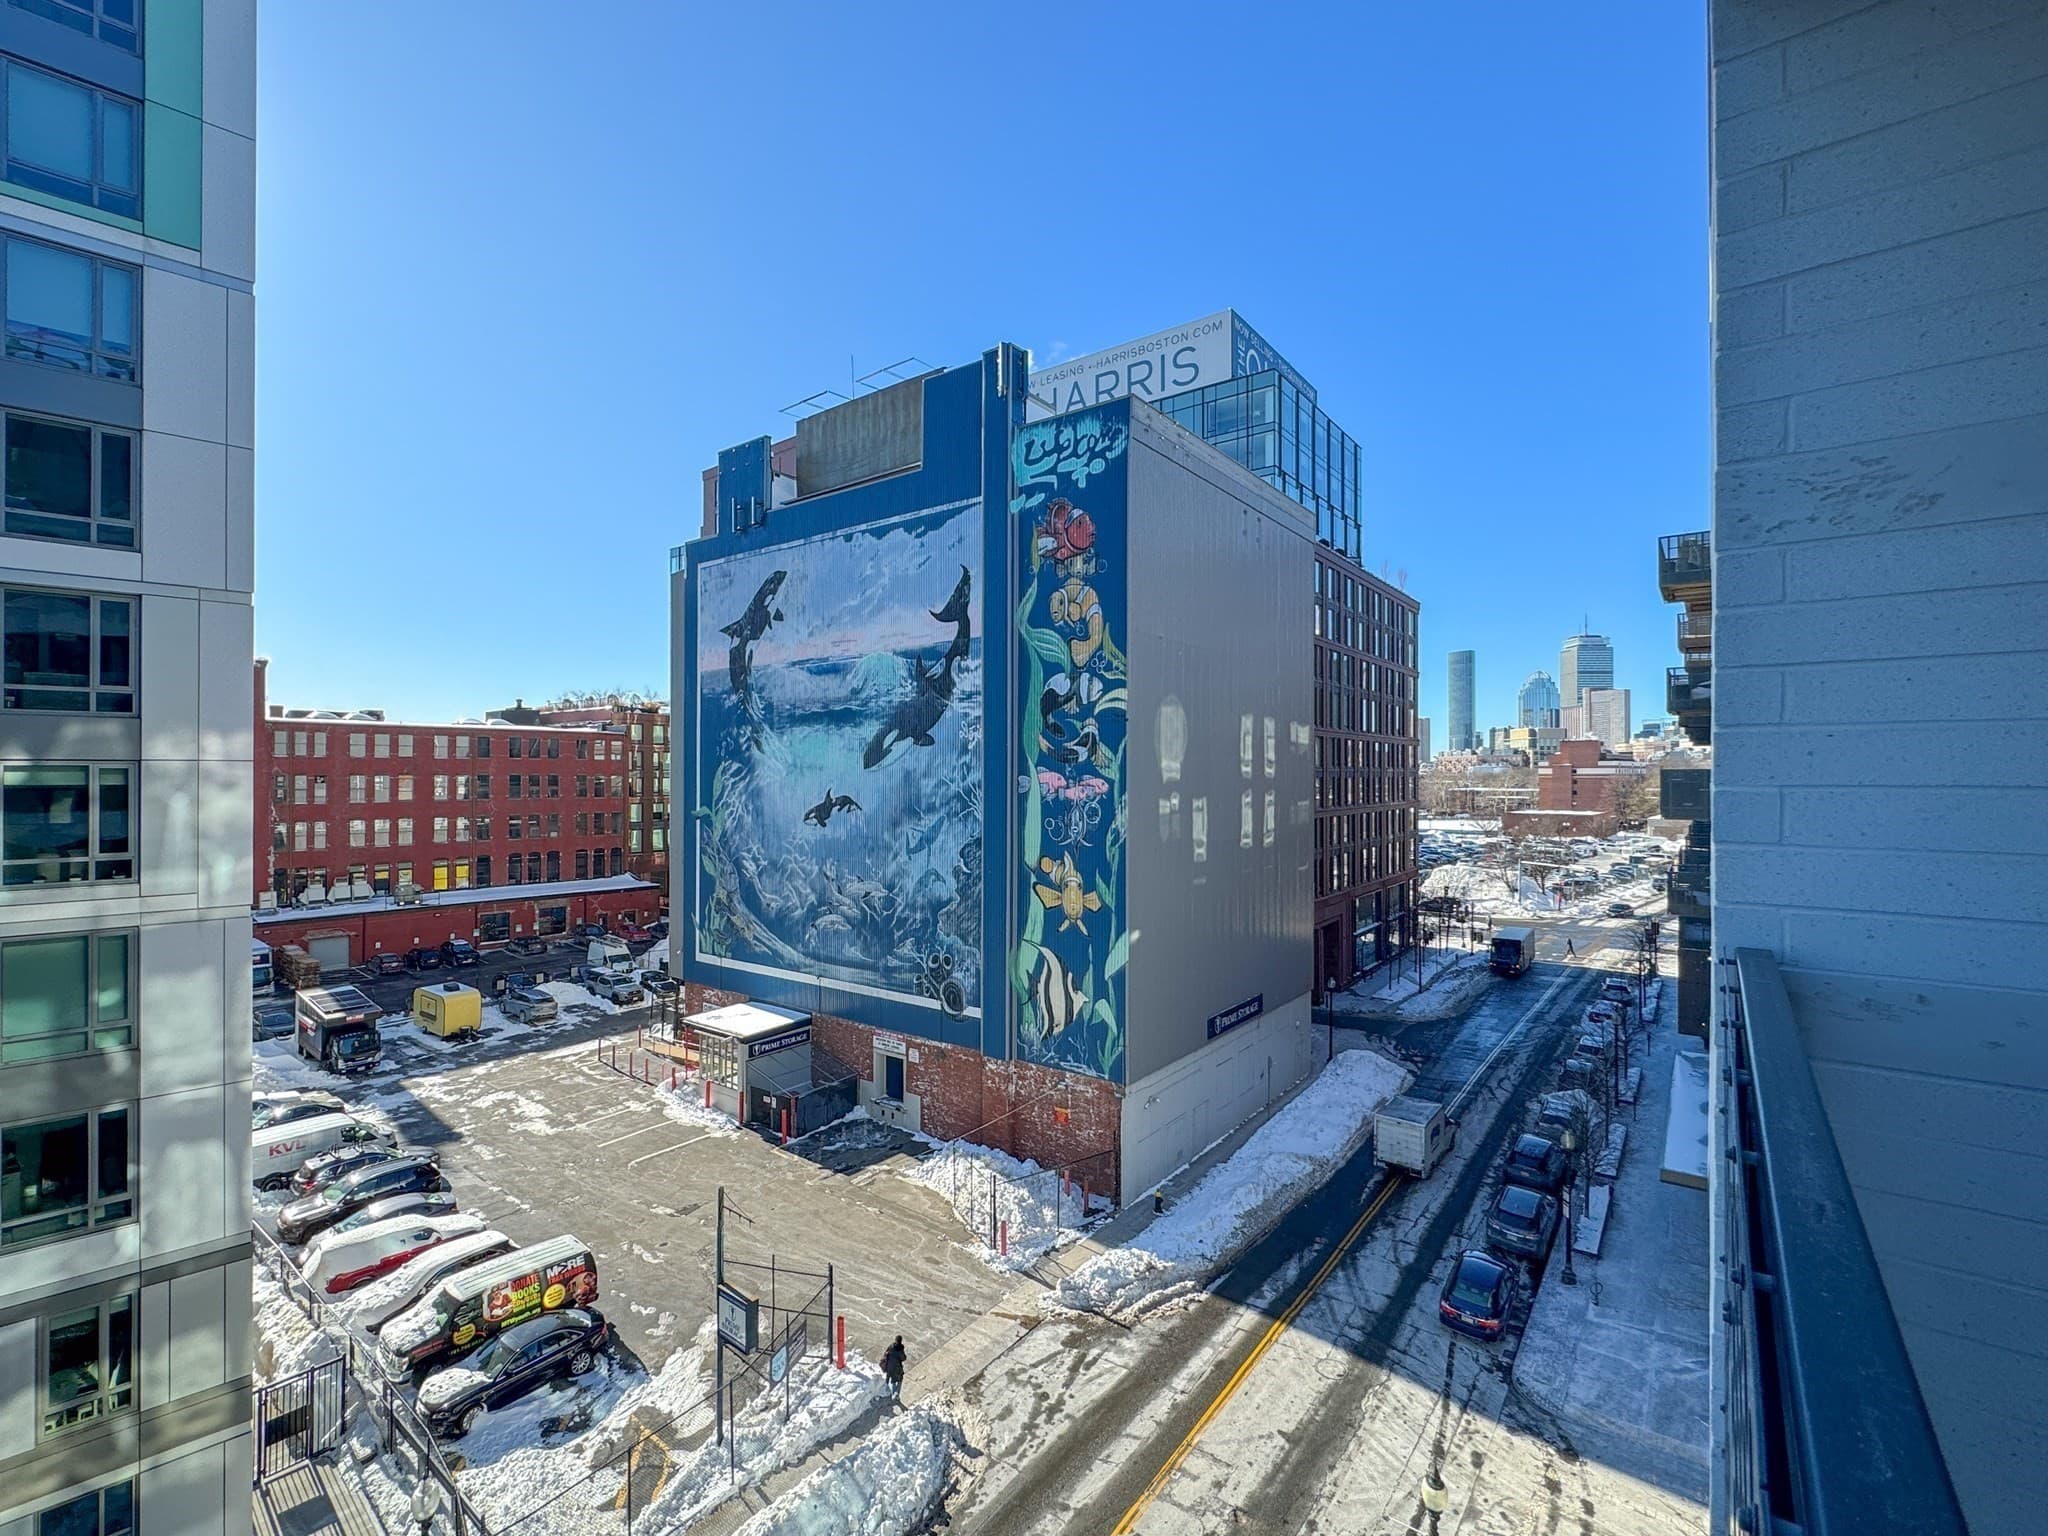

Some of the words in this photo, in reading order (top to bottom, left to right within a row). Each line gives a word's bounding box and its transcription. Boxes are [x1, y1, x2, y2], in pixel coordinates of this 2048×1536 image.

[1040, 364, 1085, 386] LEASING
[761, 1041, 781, 1053] PRIME
[781, 1032, 808, 1046] STORAGE
[269, 1139, 306, 1157] KVL
[511, 1282, 541, 1300] BOOKS
